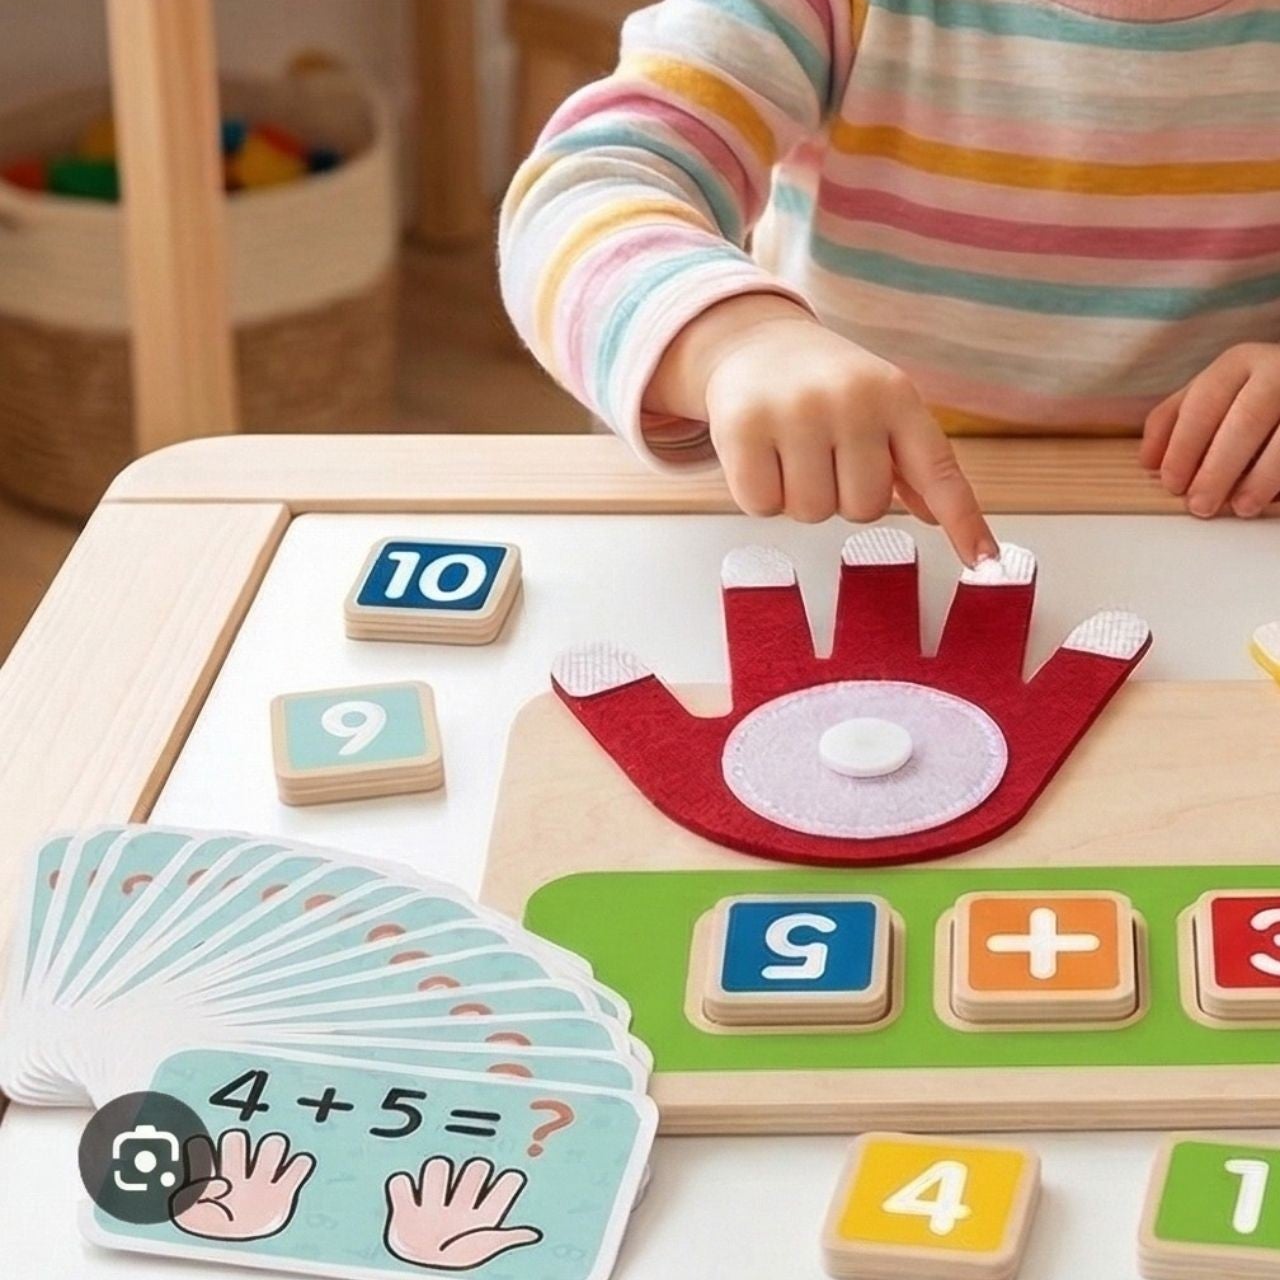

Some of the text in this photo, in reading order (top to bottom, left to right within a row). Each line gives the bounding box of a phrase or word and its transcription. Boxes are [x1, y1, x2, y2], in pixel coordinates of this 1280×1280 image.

[387, 550, 488, 602] 10
[319, 699, 390, 757] 9
[760, 912, 838, 981] 5
[985, 907, 1101, 981] +
[208, 1069, 576, 1158] 4 + 5 = ?
[881, 1159, 972, 1236] 4
[1223, 1158, 1271, 1235] 1
